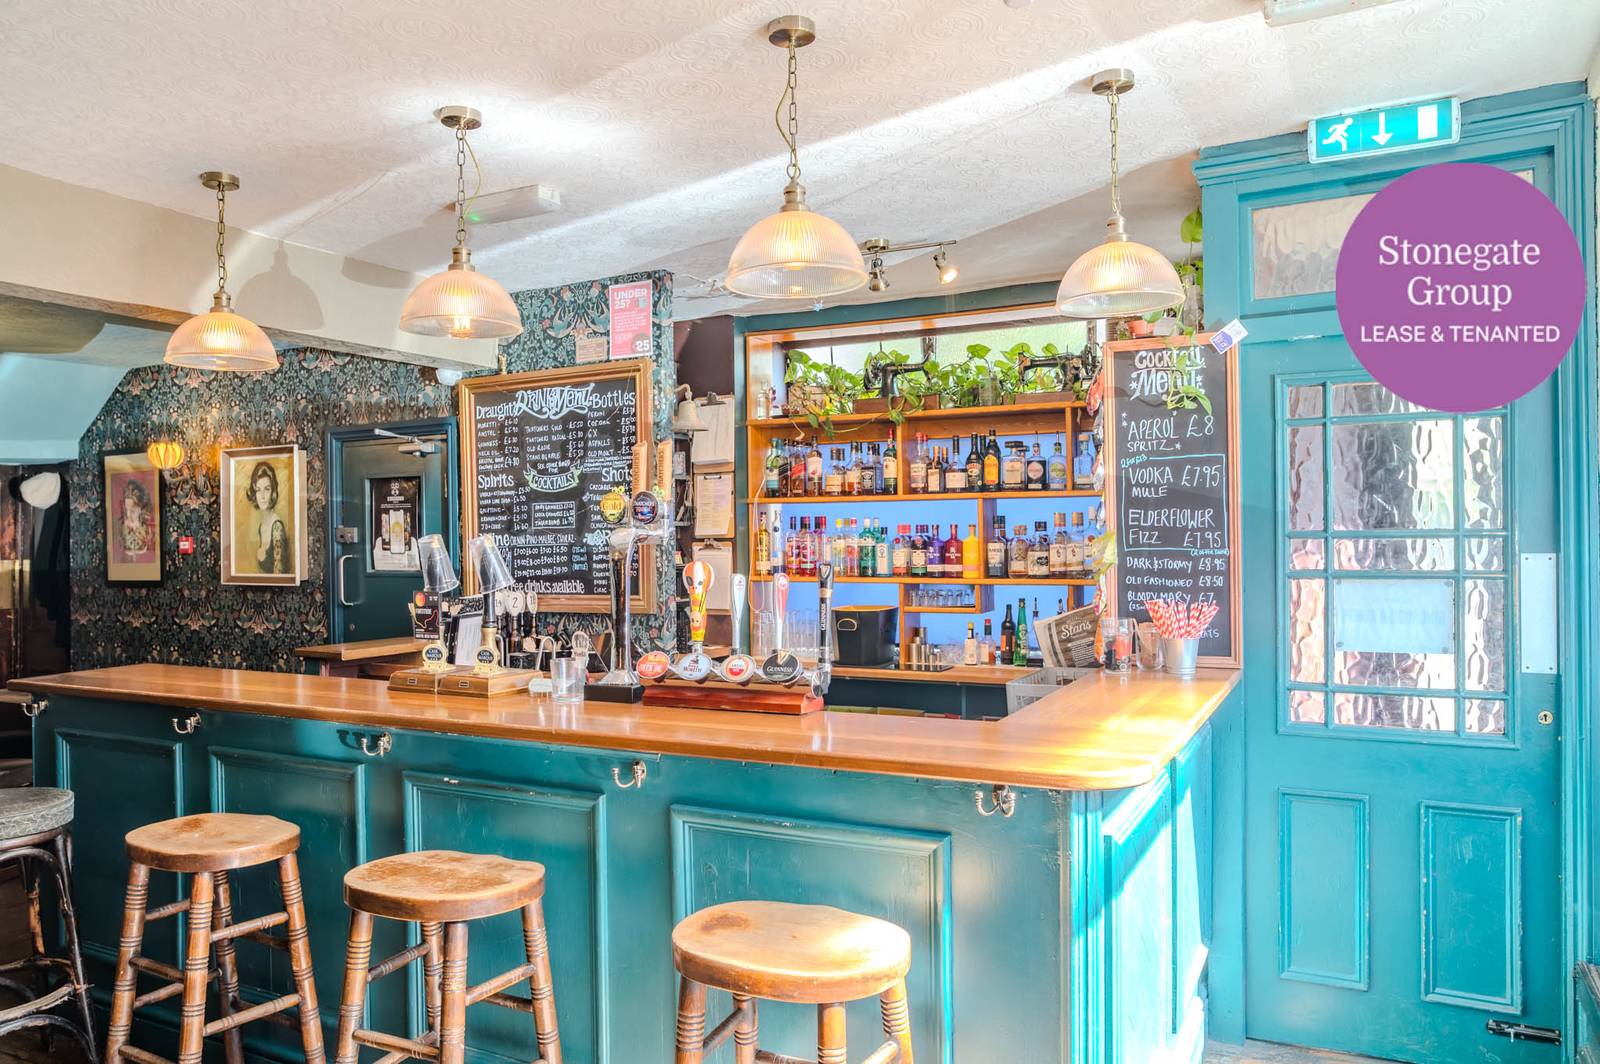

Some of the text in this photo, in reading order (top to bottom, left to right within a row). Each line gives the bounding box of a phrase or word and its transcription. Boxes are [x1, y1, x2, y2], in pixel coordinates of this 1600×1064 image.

[614, 288, 648, 300] UNDER
[614, 300, 631, 310] 25?
[635, 340, 650, 352] 25
[592, 390, 636, 408] Bottles
[1128, 414, 1214, 440] APEROL £8
[1127, 439, 1175, 452] SPRITZ
[478, 473, 515, 490] Spirits
[533, 473, 574, 490] COCKTAILS
[1129, 464, 1221, 488] VODKA £7.95
[1131, 485, 1168, 498] MULE
[602, 501, 622, 511] Gold
[1128, 508, 1216, 529] ELDERFLOWER
[1129, 528, 1221, 548] FIZZ £7.95
[1126, 557, 1152, 569] DARK
[1198, 557, 1226, 571] £8.95
[524, 579, 551, 594] drinks
[551, 579, 585, 594] available
[1126, 575, 1224, 588] OLD FASHIONED £8.50
[512, 596, 519, 609] 2
[1127, 590, 1158, 602] BLOODY
[1160, 590, 1191, 606] MARY
[1061, 621, 1092, 640] Stan's
[766, 665, 793, 673] GUINNESS
